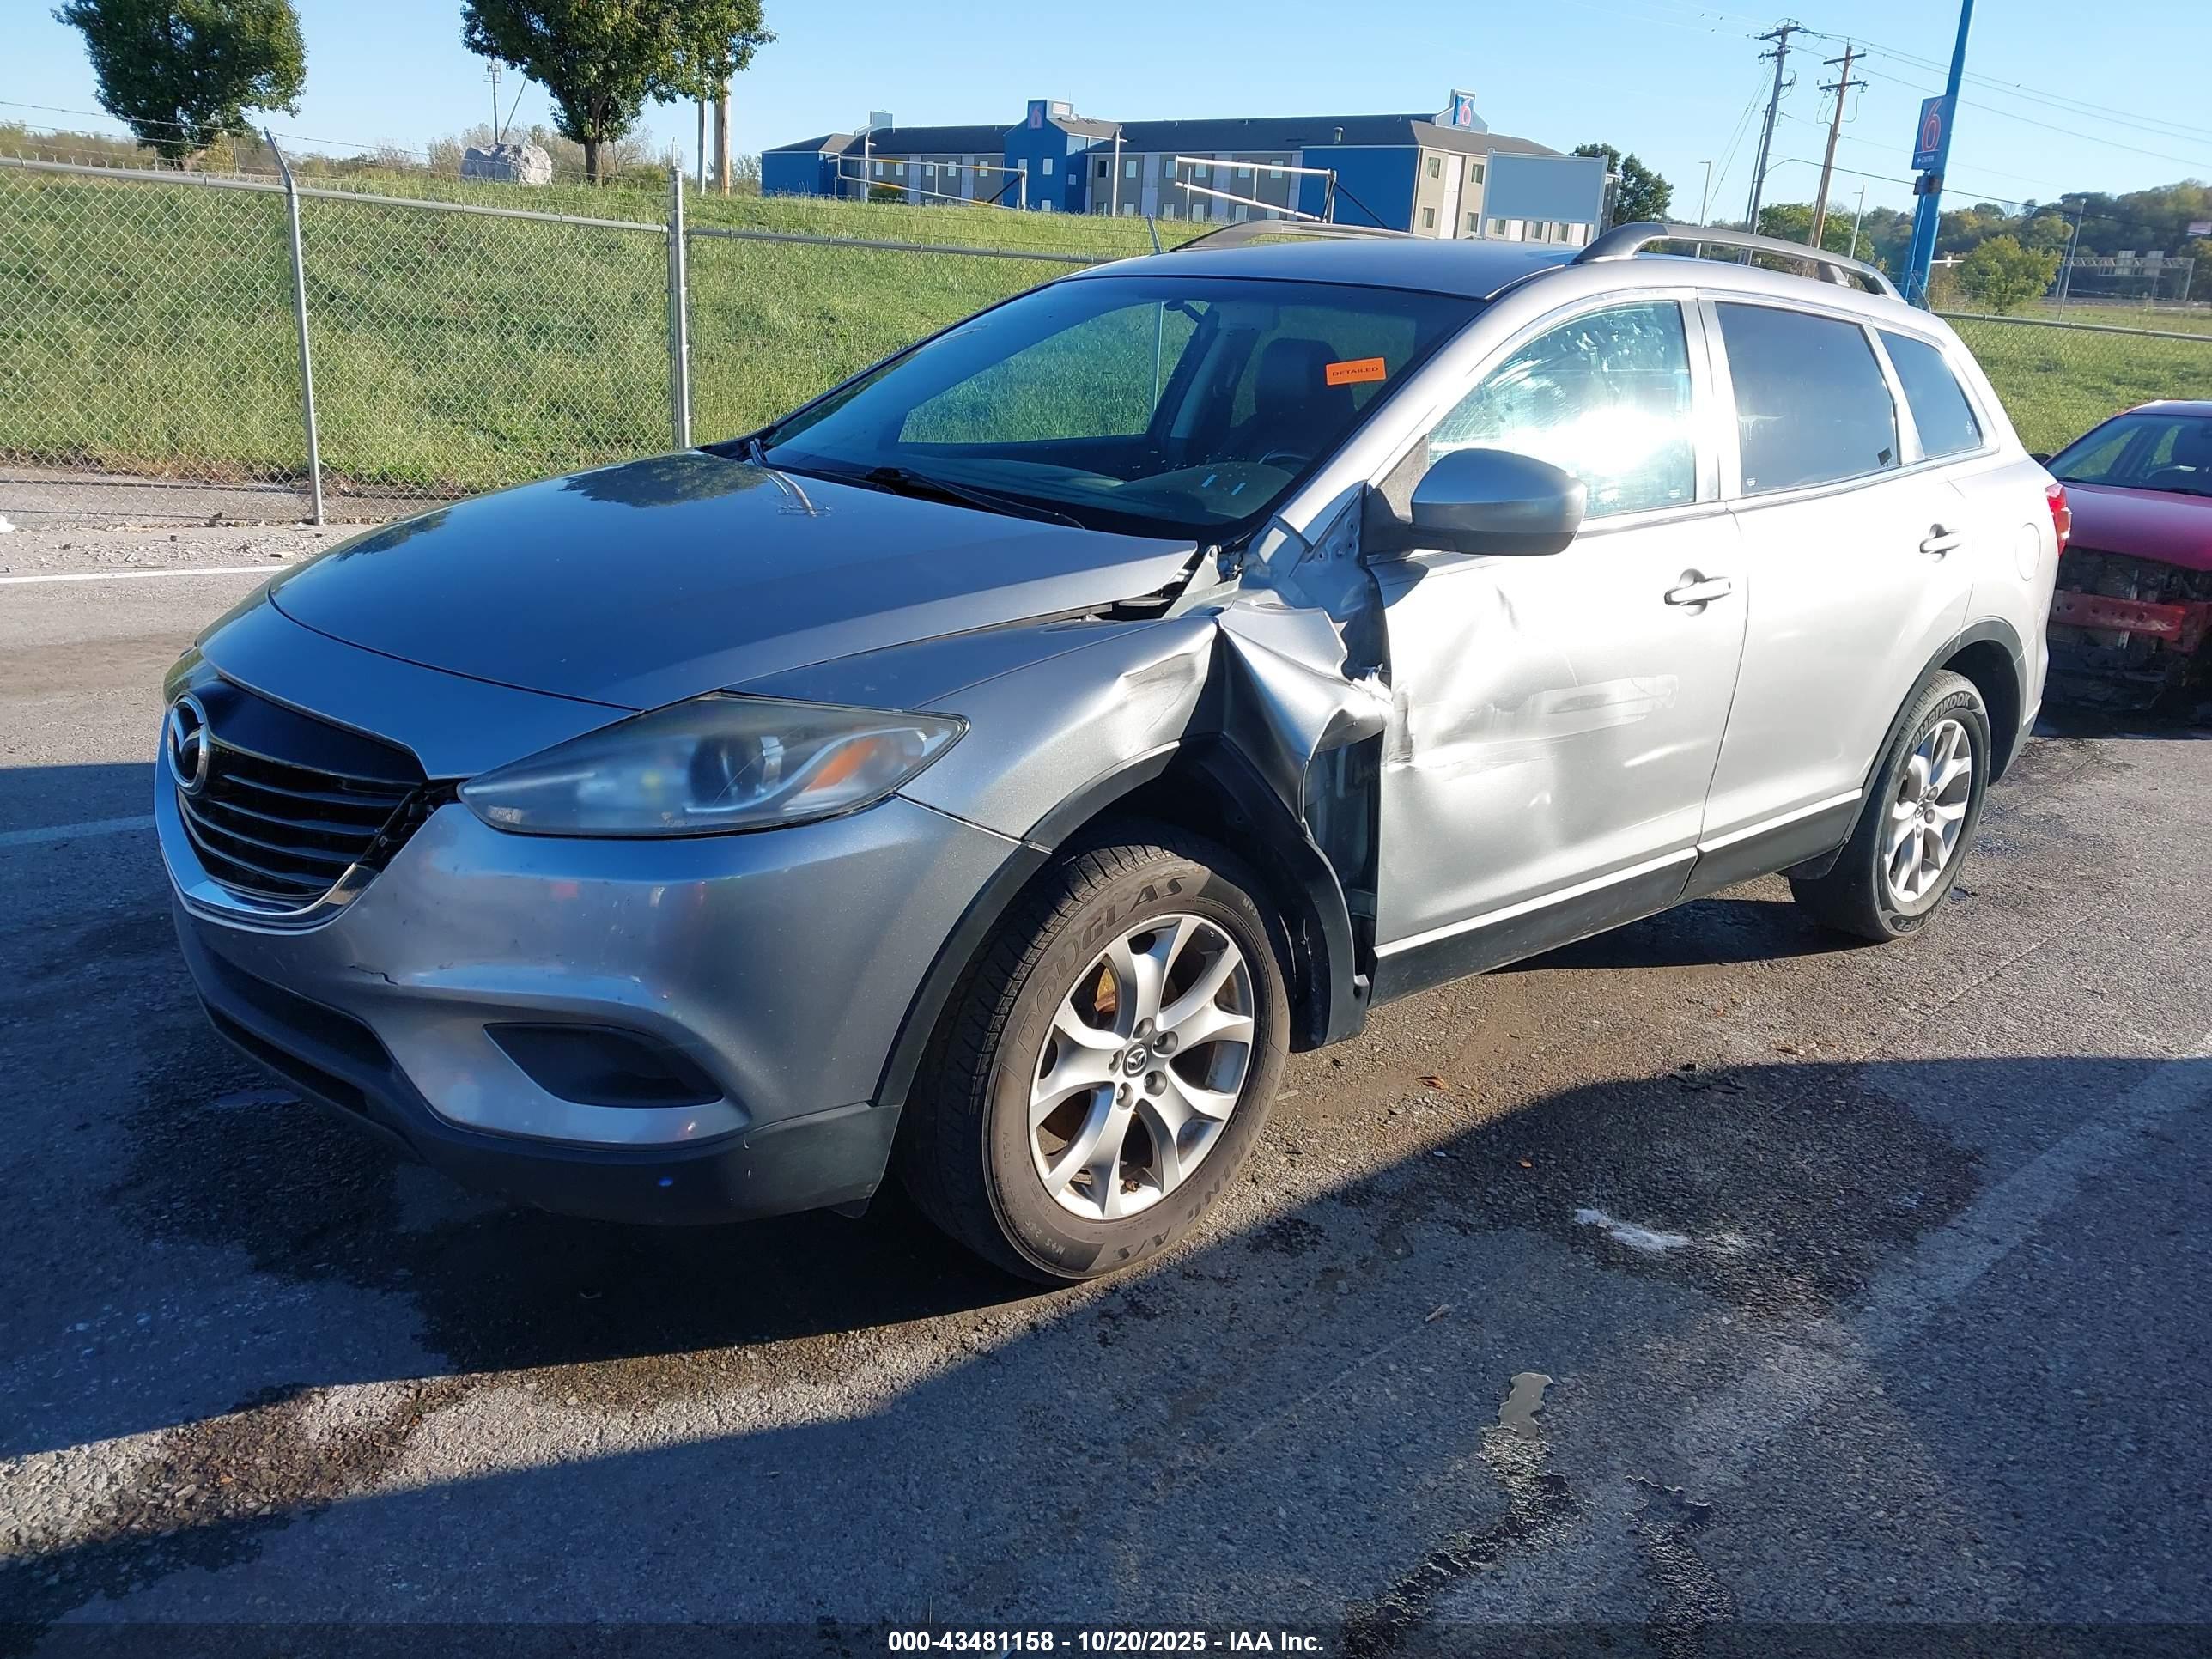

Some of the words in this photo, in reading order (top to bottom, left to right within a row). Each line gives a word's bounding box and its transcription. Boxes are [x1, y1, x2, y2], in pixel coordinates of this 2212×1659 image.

[1922, 99, 1942, 151] 6
[1332, 366, 1379, 377] DETAILED
[1018, 876, 1186, 1054] DOUGLAS
